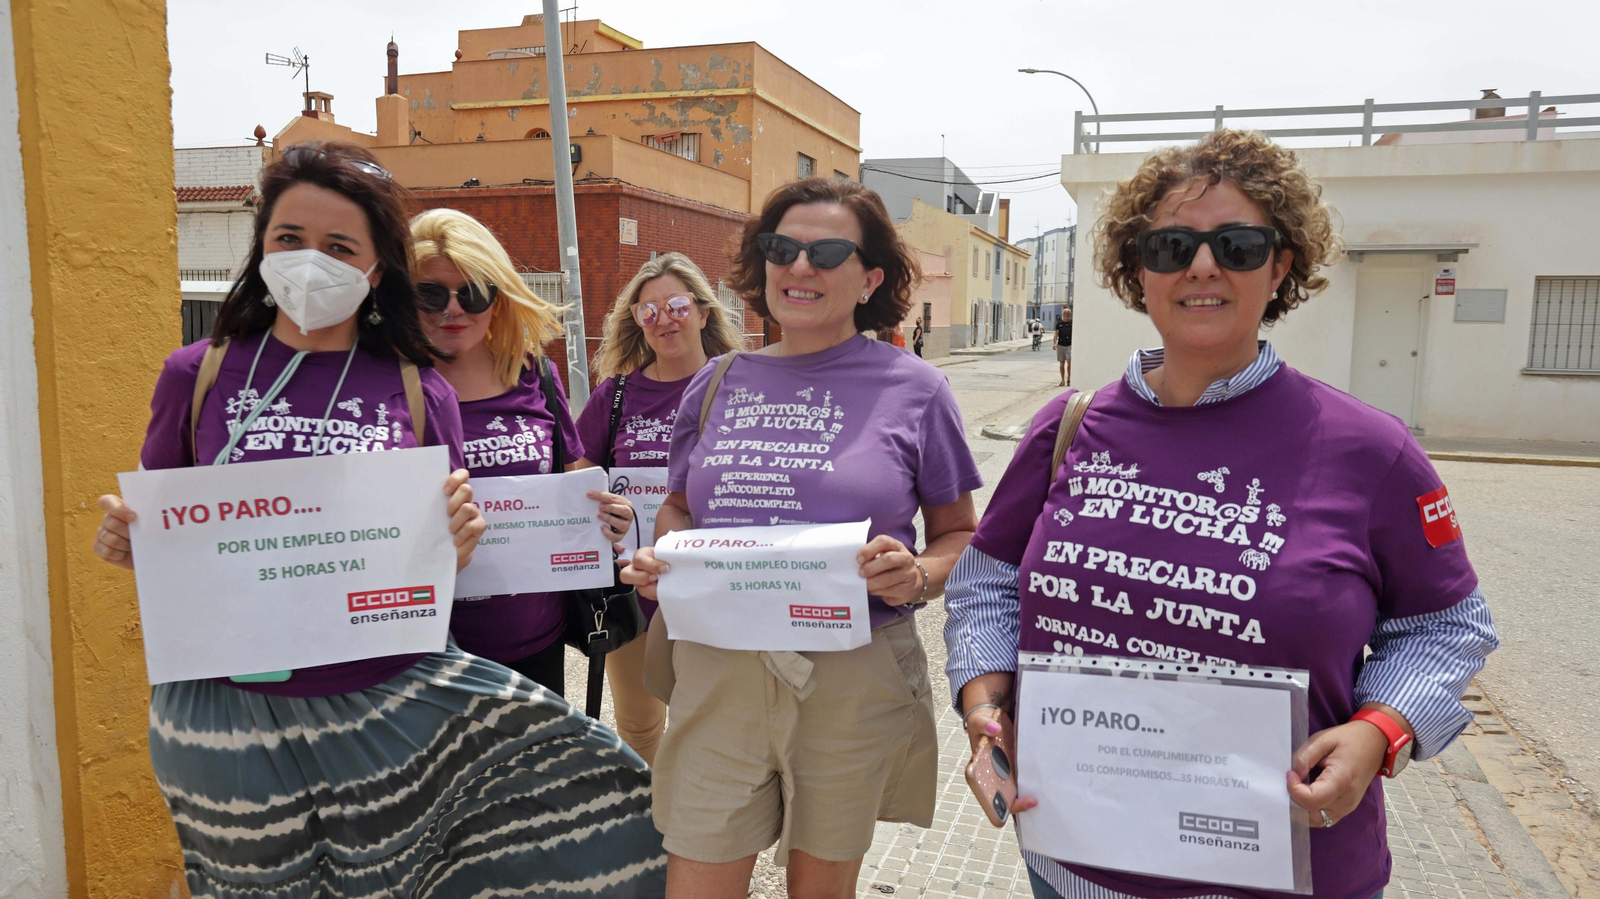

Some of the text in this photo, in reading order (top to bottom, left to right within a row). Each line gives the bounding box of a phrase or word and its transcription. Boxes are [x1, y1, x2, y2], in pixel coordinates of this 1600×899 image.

[613, 390, 622, 409] TOUS
[734, 416, 759, 429] EN
[762, 416, 826, 432] LUCHA
[244, 432, 286, 450] EN
[713, 440, 830, 454] EN PRECARIO
[701, 455, 835, 472] POR LA JUNTA
[721, 472, 790, 483] #EXPERIENCIA
[714, 481, 795, 496] #AÑOCOMPLETO
[484, 499, 539, 512] PARO....
[708, 498, 802, 510] #JORNADACOMPLETA
[161, 496, 322, 530] ¡YO PARO....
[494, 521, 525, 530] MISMO
[527, 519, 565, 528] TRABAJO
[567, 517, 591, 525] IGUAL
[1078, 499, 1124, 519] EN
[1129, 504, 1251, 546] LUCHA
[218, 526, 401, 554] POR UN EMPLEO DIGNO
[675, 539, 774, 550] ¡YO PARO....
[552, 554, 584, 563] CCOO
[704, 560, 827, 570] POR UN EMPLEO DIGNO
[259, 558, 365, 581] 35 HORAS YA!
[552, 564, 600, 572] enseñanza
[1043, 541, 1256, 601] EN PRECARIO
[730, 581, 801, 591] 35 HORAS YA!
[352, 591, 410, 608] CCOO
[1028, 572, 1265, 644] POR LA JUNTA
[350, 607, 437, 625] enseñanza
[792, 607, 832, 618] CCOO
[791, 619, 852, 629] enseñanza
[1035, 615, 1119, 649] JORNADA
[1041, 707, 1164, 734] ¡YO PARO....
[1098, 744, 1228, 766] POR EL CUMPLIMIENTO DE
[1076, 763, 1094, 773] LOS
[1194, 775, 1229, 787] HORAS
[1183, 814, 1233, 833] CCOO
[1179, 833, 1259, 852] enseñanza
